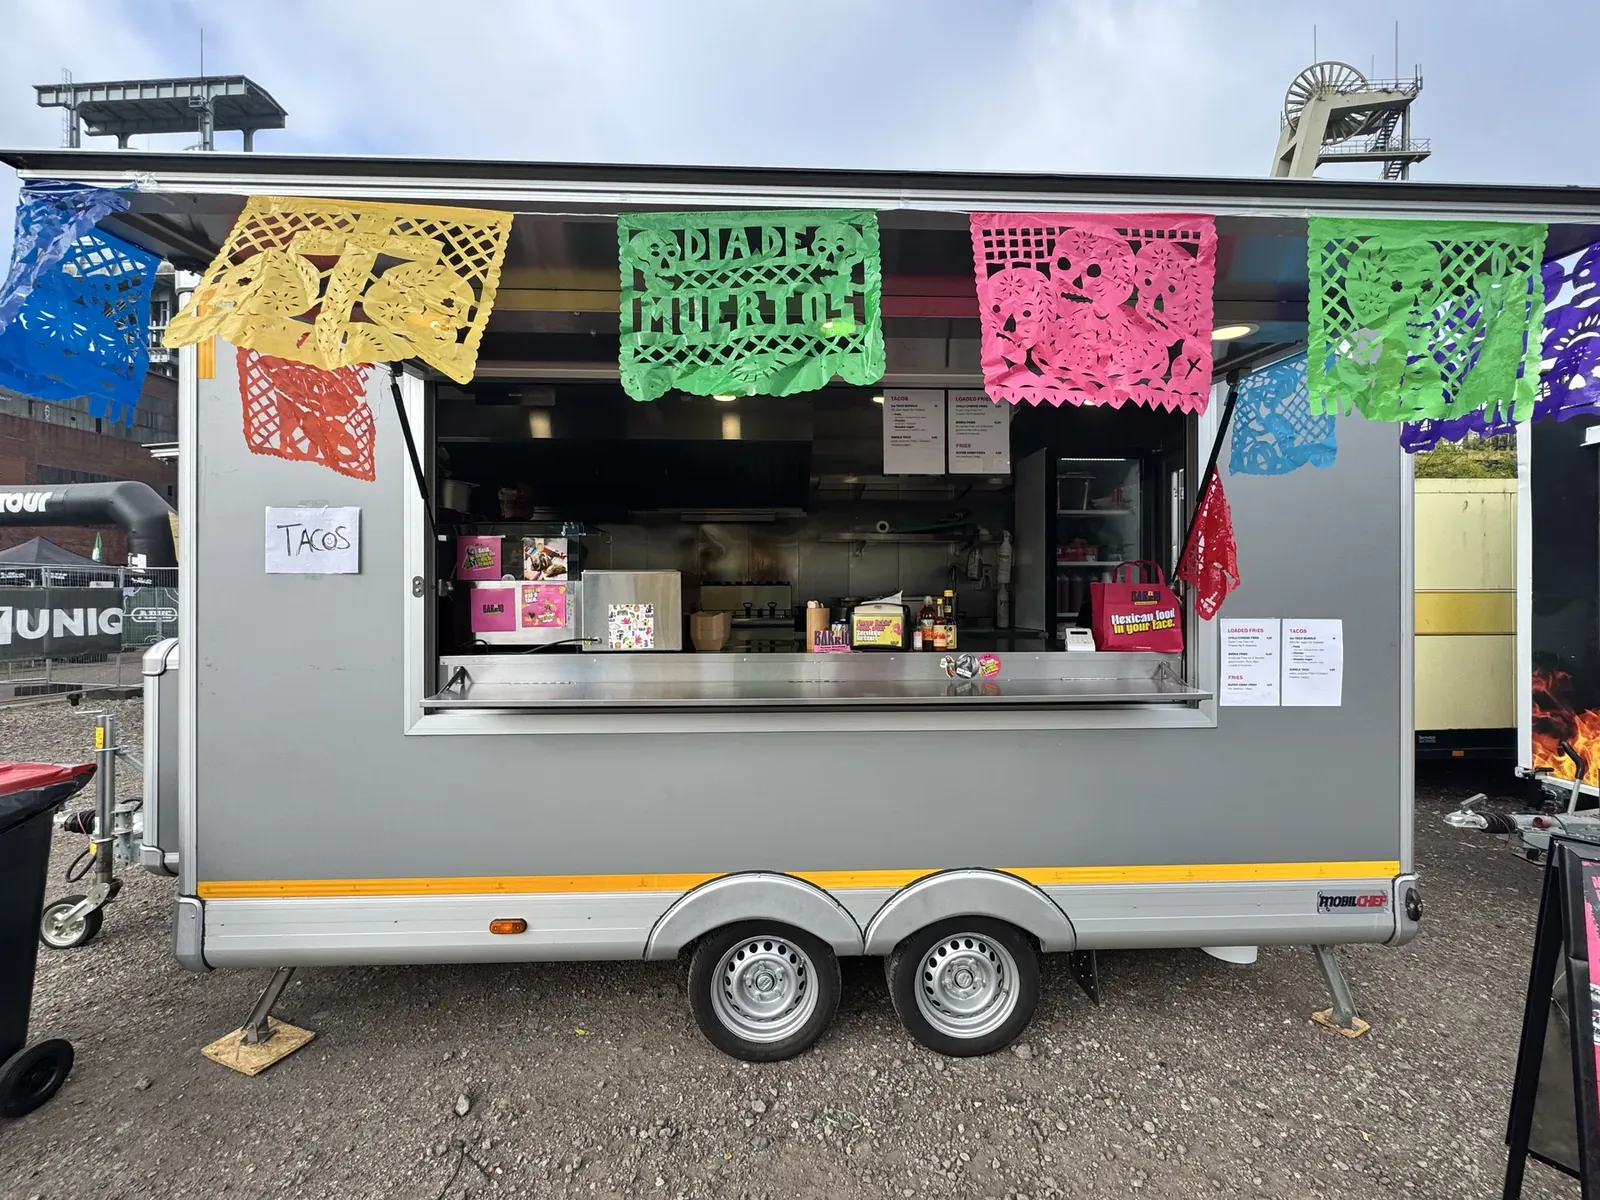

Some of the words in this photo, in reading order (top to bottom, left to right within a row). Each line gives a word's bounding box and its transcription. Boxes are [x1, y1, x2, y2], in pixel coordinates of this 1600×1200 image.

[684, 226, 753, 262] DIA
[761, 224, 808, 259] DE
[276, 523, 351, 556] TACOS
[1112, 613, 1154, 625] Mexican
[1156, 608, 1175, 621] food
[1113, 624, 1125, 635] in
[1126, 622, 1151, 635] your
[1152, 618, 1176, 631] face.
